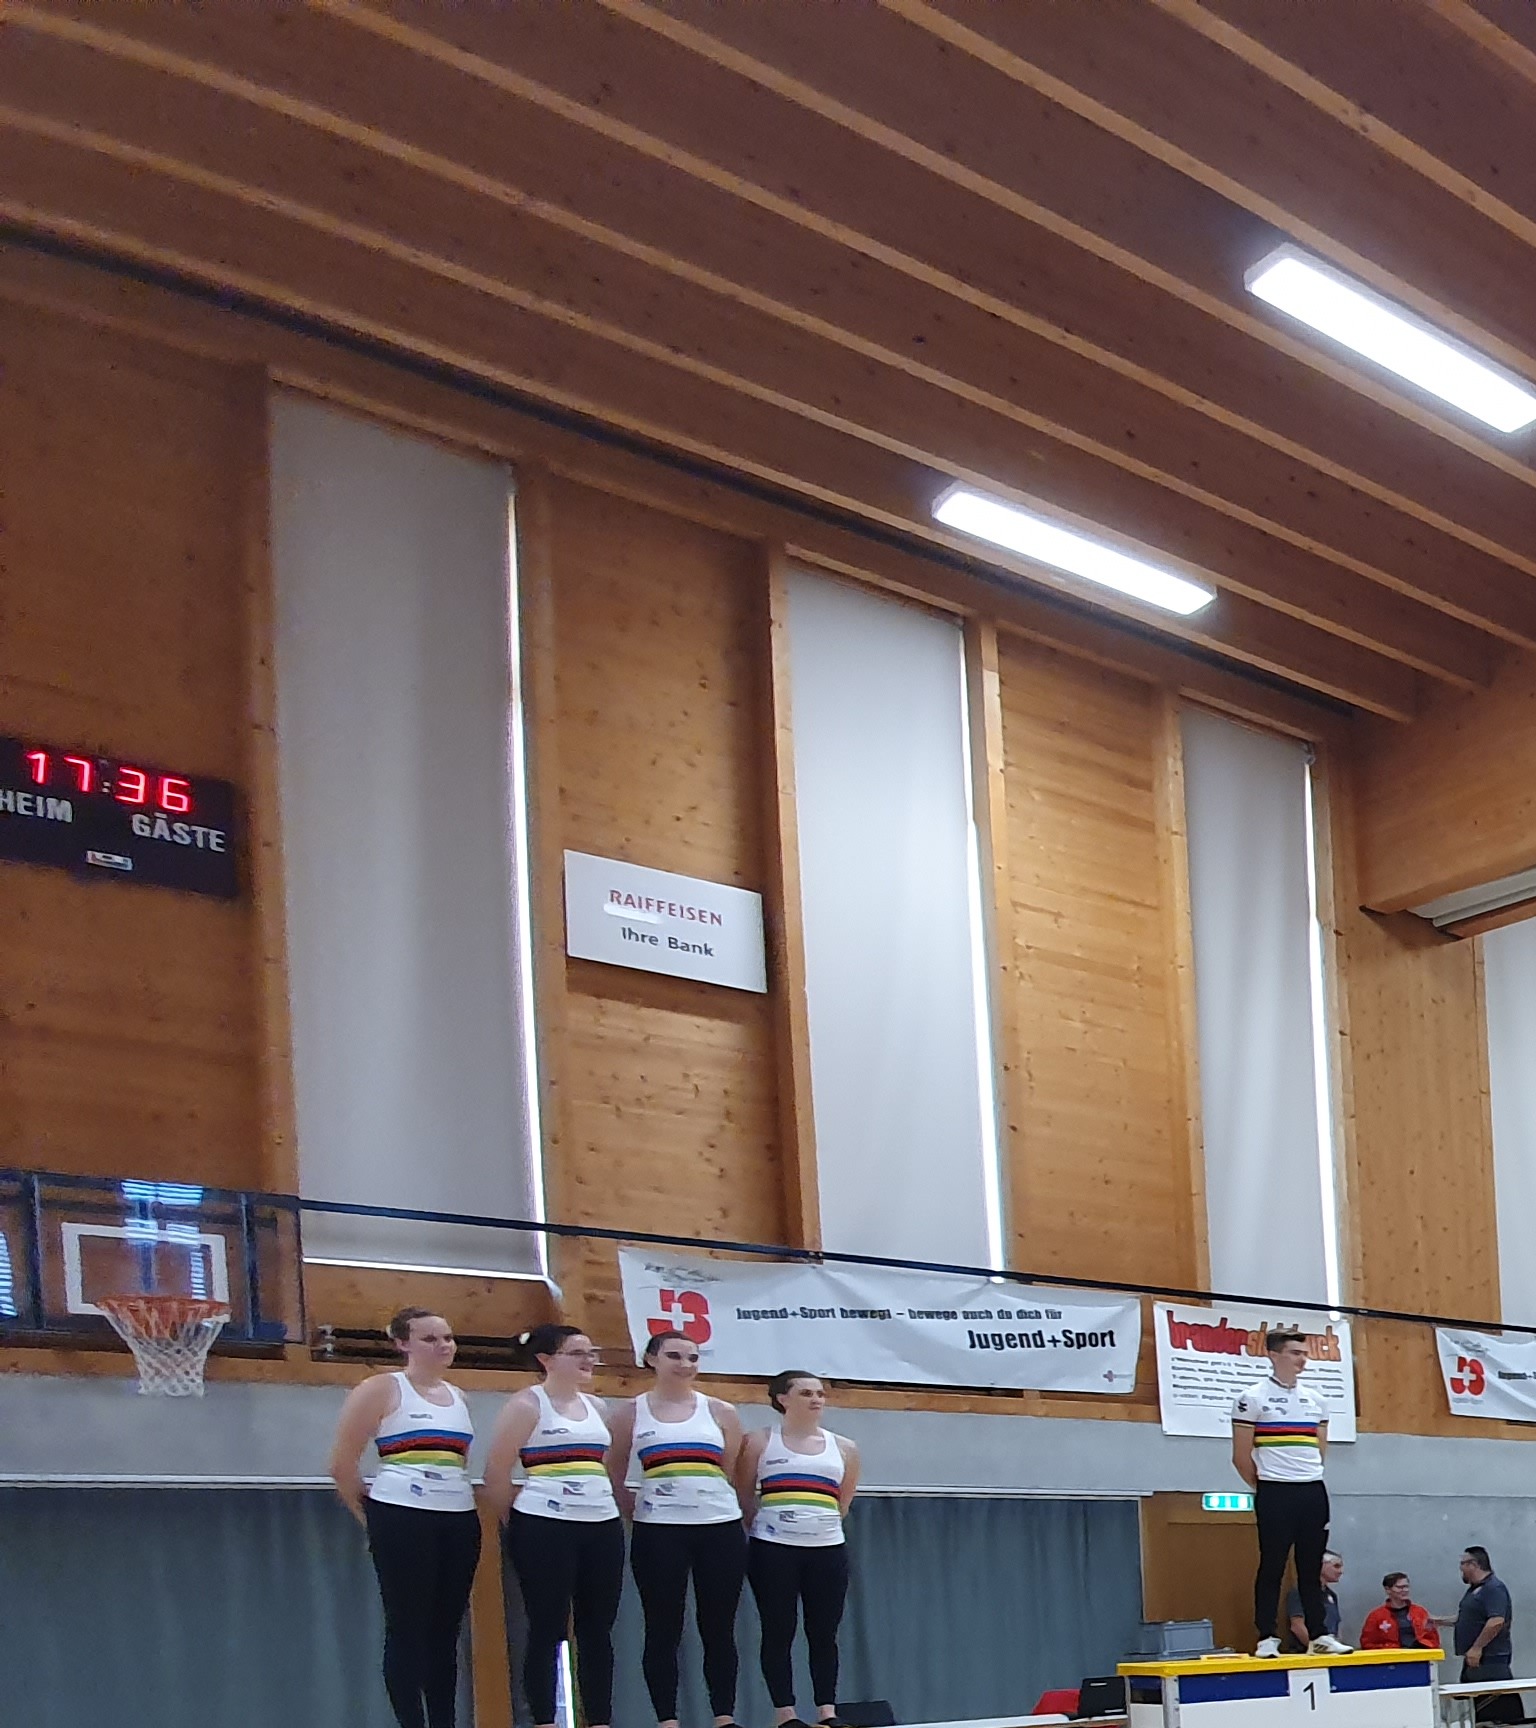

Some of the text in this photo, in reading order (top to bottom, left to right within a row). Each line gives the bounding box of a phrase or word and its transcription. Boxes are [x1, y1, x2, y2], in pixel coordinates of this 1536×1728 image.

[26, 751, 190, 813] 17:36
[132, 812, 227, 852] GÄSTE
[609, 889, 723, 926] RAIFFEISEN
[621, 926, 715, 957] Ihre Bank
[967, 1329, 1117, 1350] Jugend+Sport
[1303, 1682, 1316, 1711] 1
